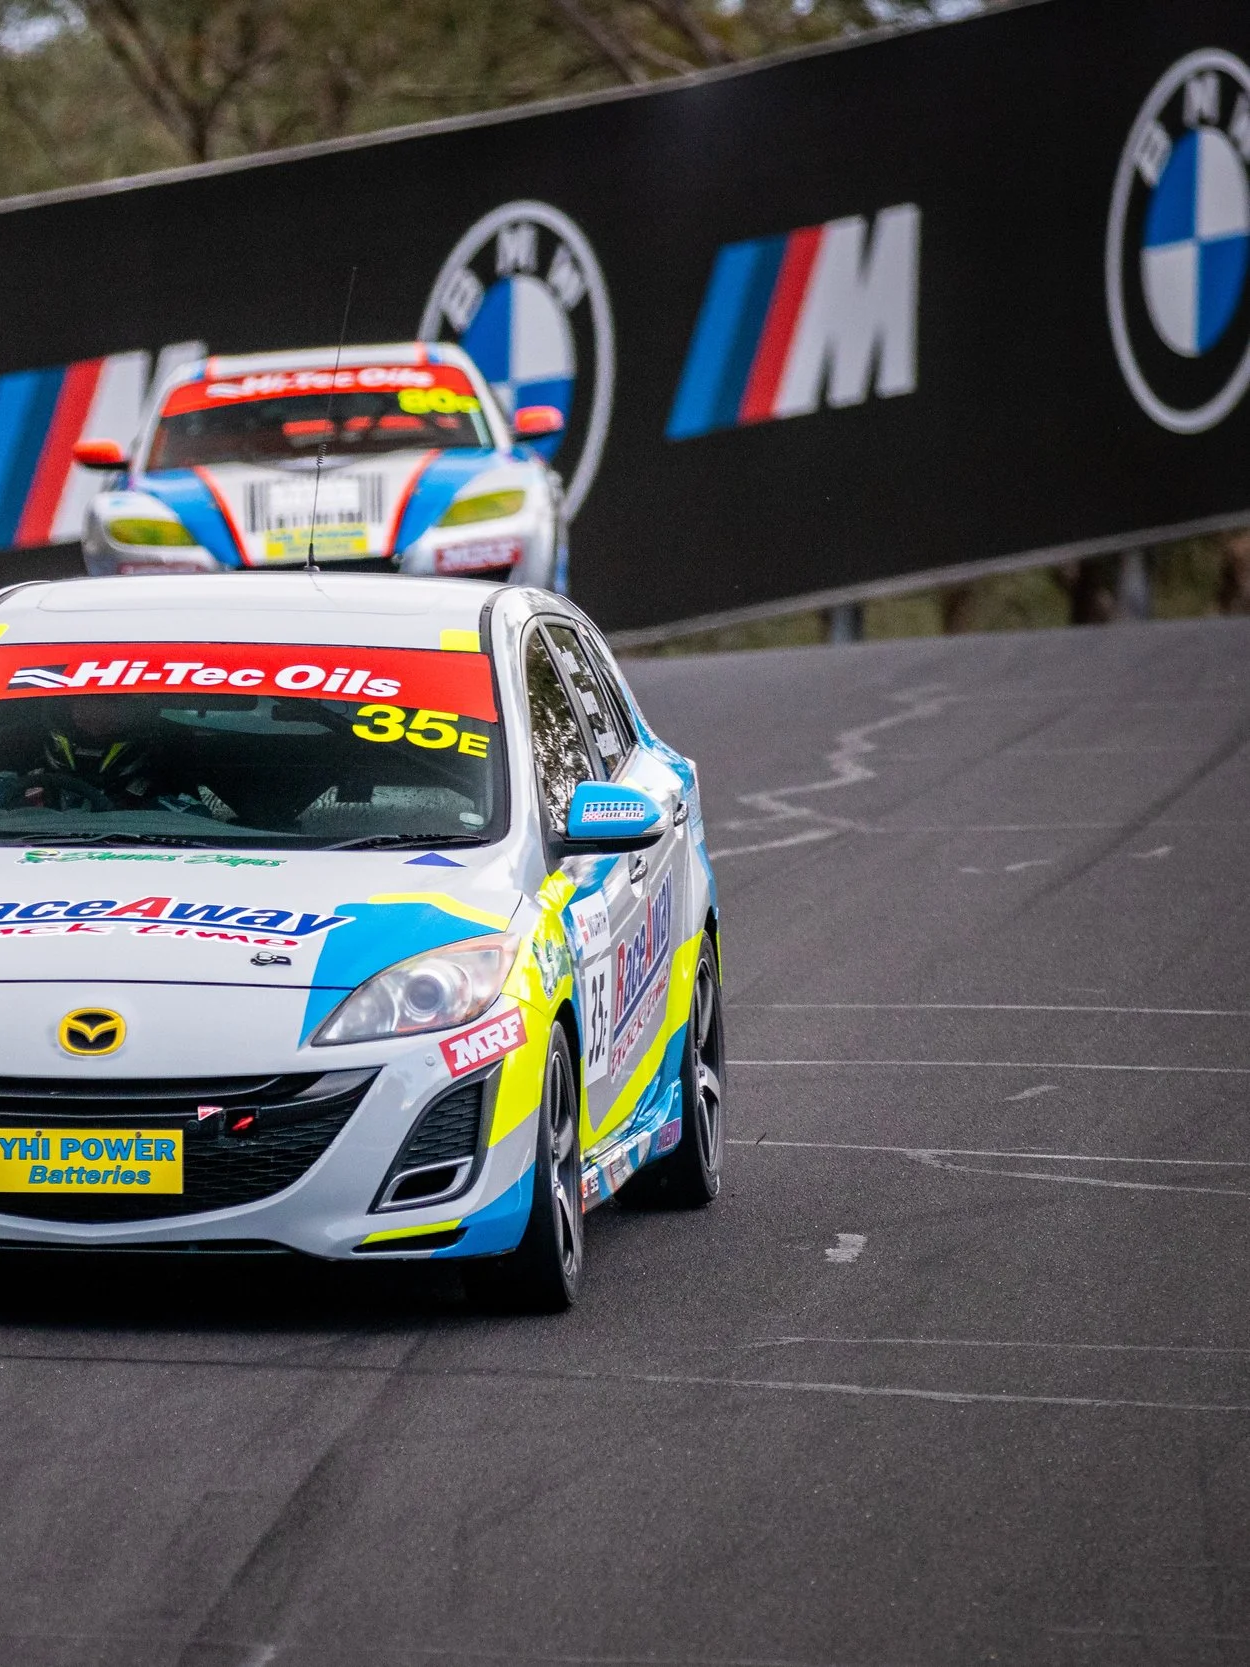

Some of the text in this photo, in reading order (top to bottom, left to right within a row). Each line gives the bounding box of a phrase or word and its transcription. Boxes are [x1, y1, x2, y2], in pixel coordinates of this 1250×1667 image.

[441, 222, 587, 333] BMW
[243, 368, 436, 397] Hi-Tec Oils
[69, 660, 402, 697] Hi-Tec Oils
[352, 704, 490, 759] 35E
[136, 924, 299, 946] time
[449, 1012, 521, 1070] MRF
[60, 1138, 176, 1161] POWER
[28, 1164, 152, 1185] Batteries
